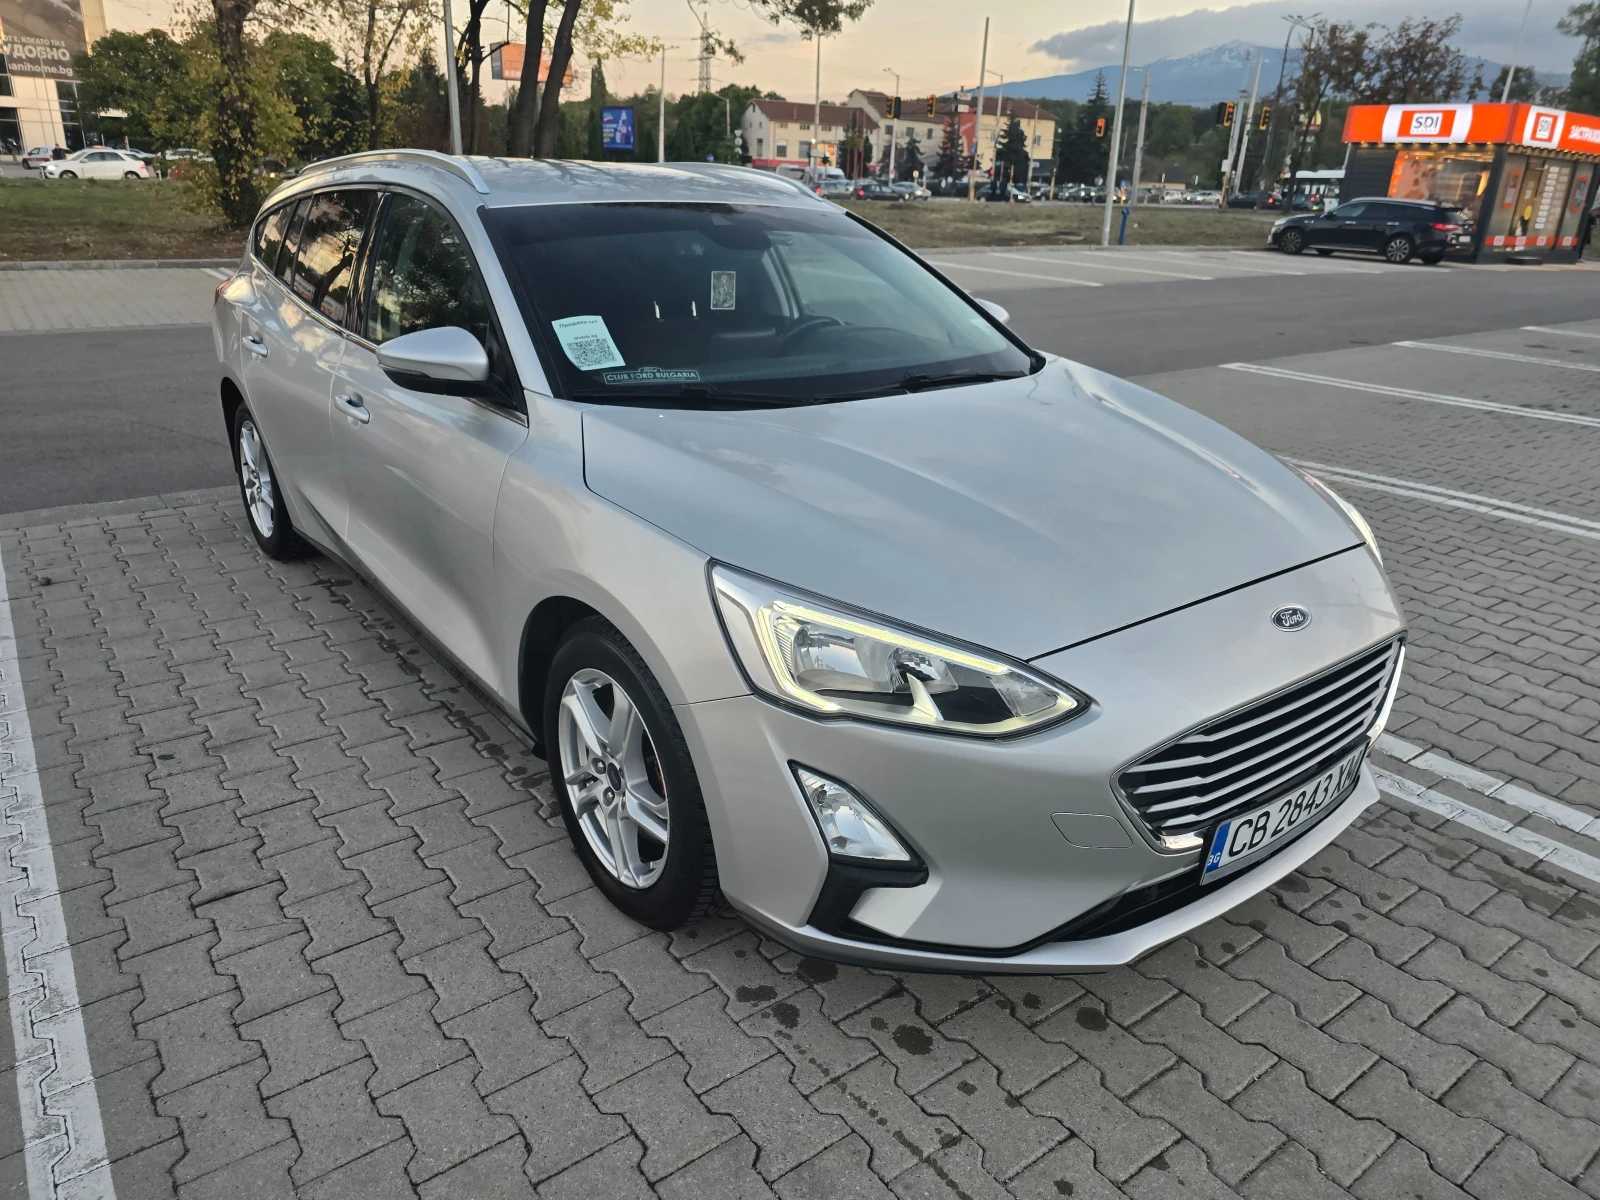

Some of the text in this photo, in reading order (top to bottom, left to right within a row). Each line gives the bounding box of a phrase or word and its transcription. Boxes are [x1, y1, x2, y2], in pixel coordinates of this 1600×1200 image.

[22, 36, 50, 45] КОГАТО
[1413, 116, 1440, 129] SDI
[559, 320, 587, 328] Продава
[606, 373, 629, 381] CLUB
[655, 371, 697, 379] BULGARIA
[1280, 609, 1304, 627] Ford
[1228, 810, 1271, 857] CB
[1270, 773, 1333, 838] 2843
